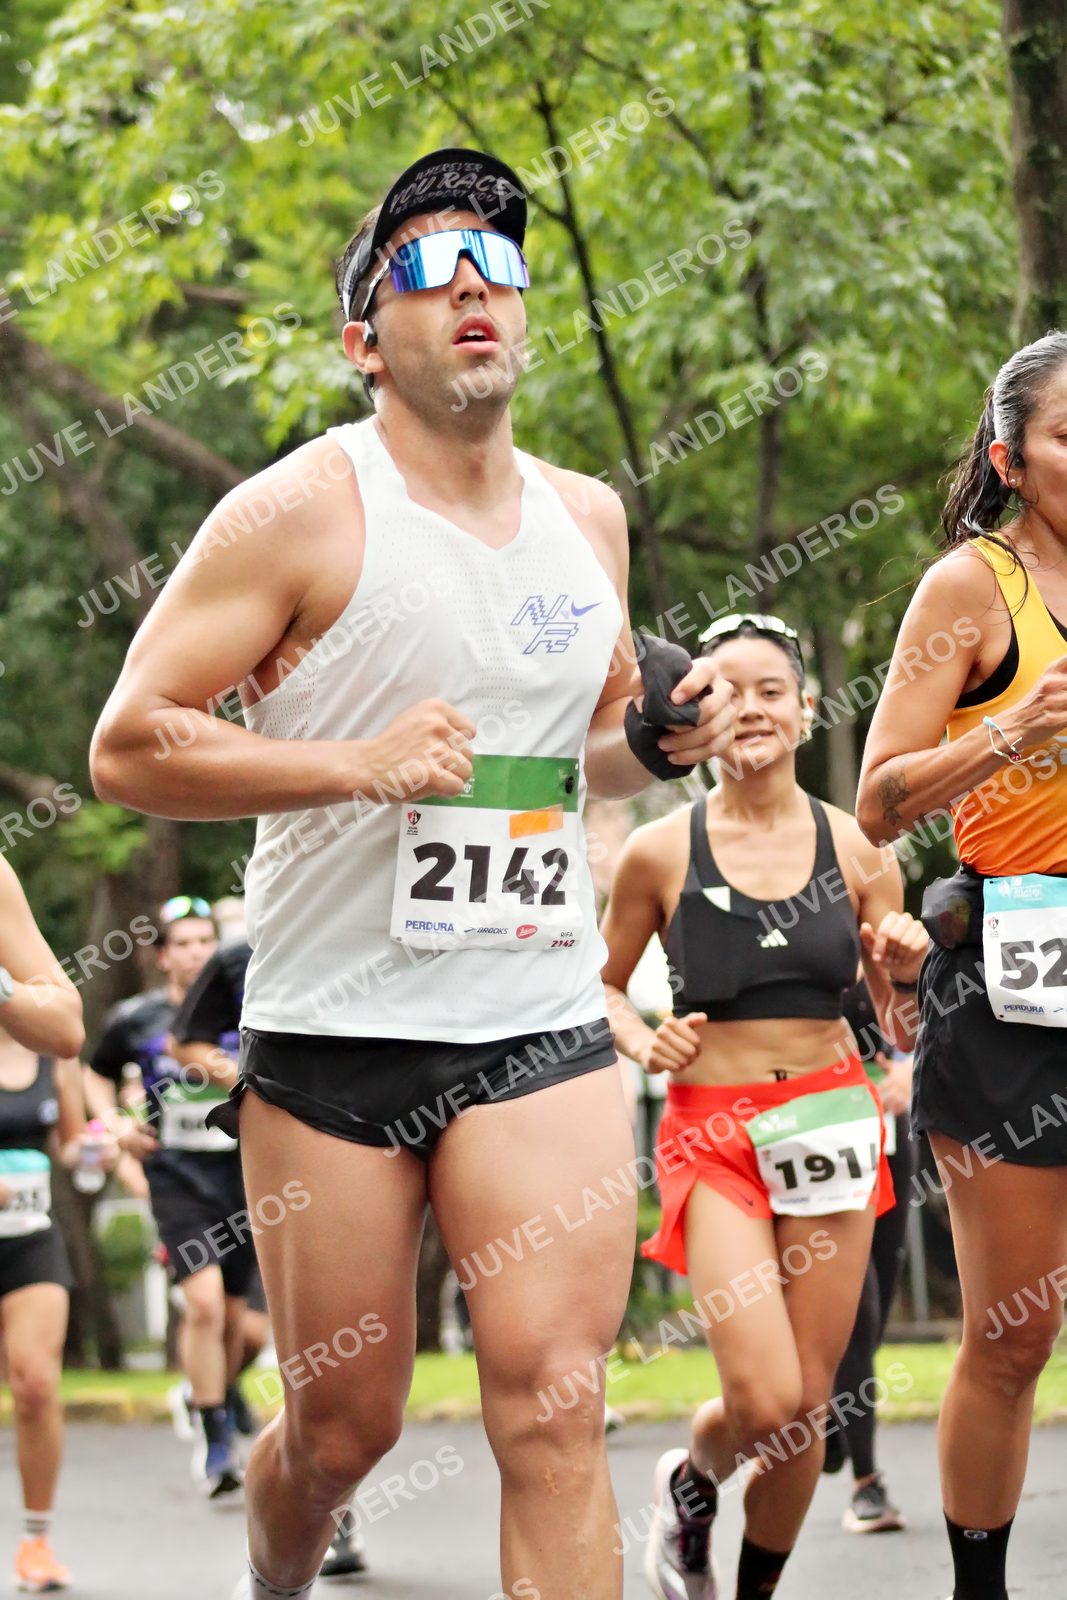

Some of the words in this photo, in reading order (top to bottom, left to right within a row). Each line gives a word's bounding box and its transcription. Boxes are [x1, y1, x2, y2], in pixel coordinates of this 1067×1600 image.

[410, 842, 569, 905] 2142
[405, 920, 455, 932] PERDURA
[551, 939, 576, 948] 2142
[1003, 1004, 1045, 1014] PERDURA
